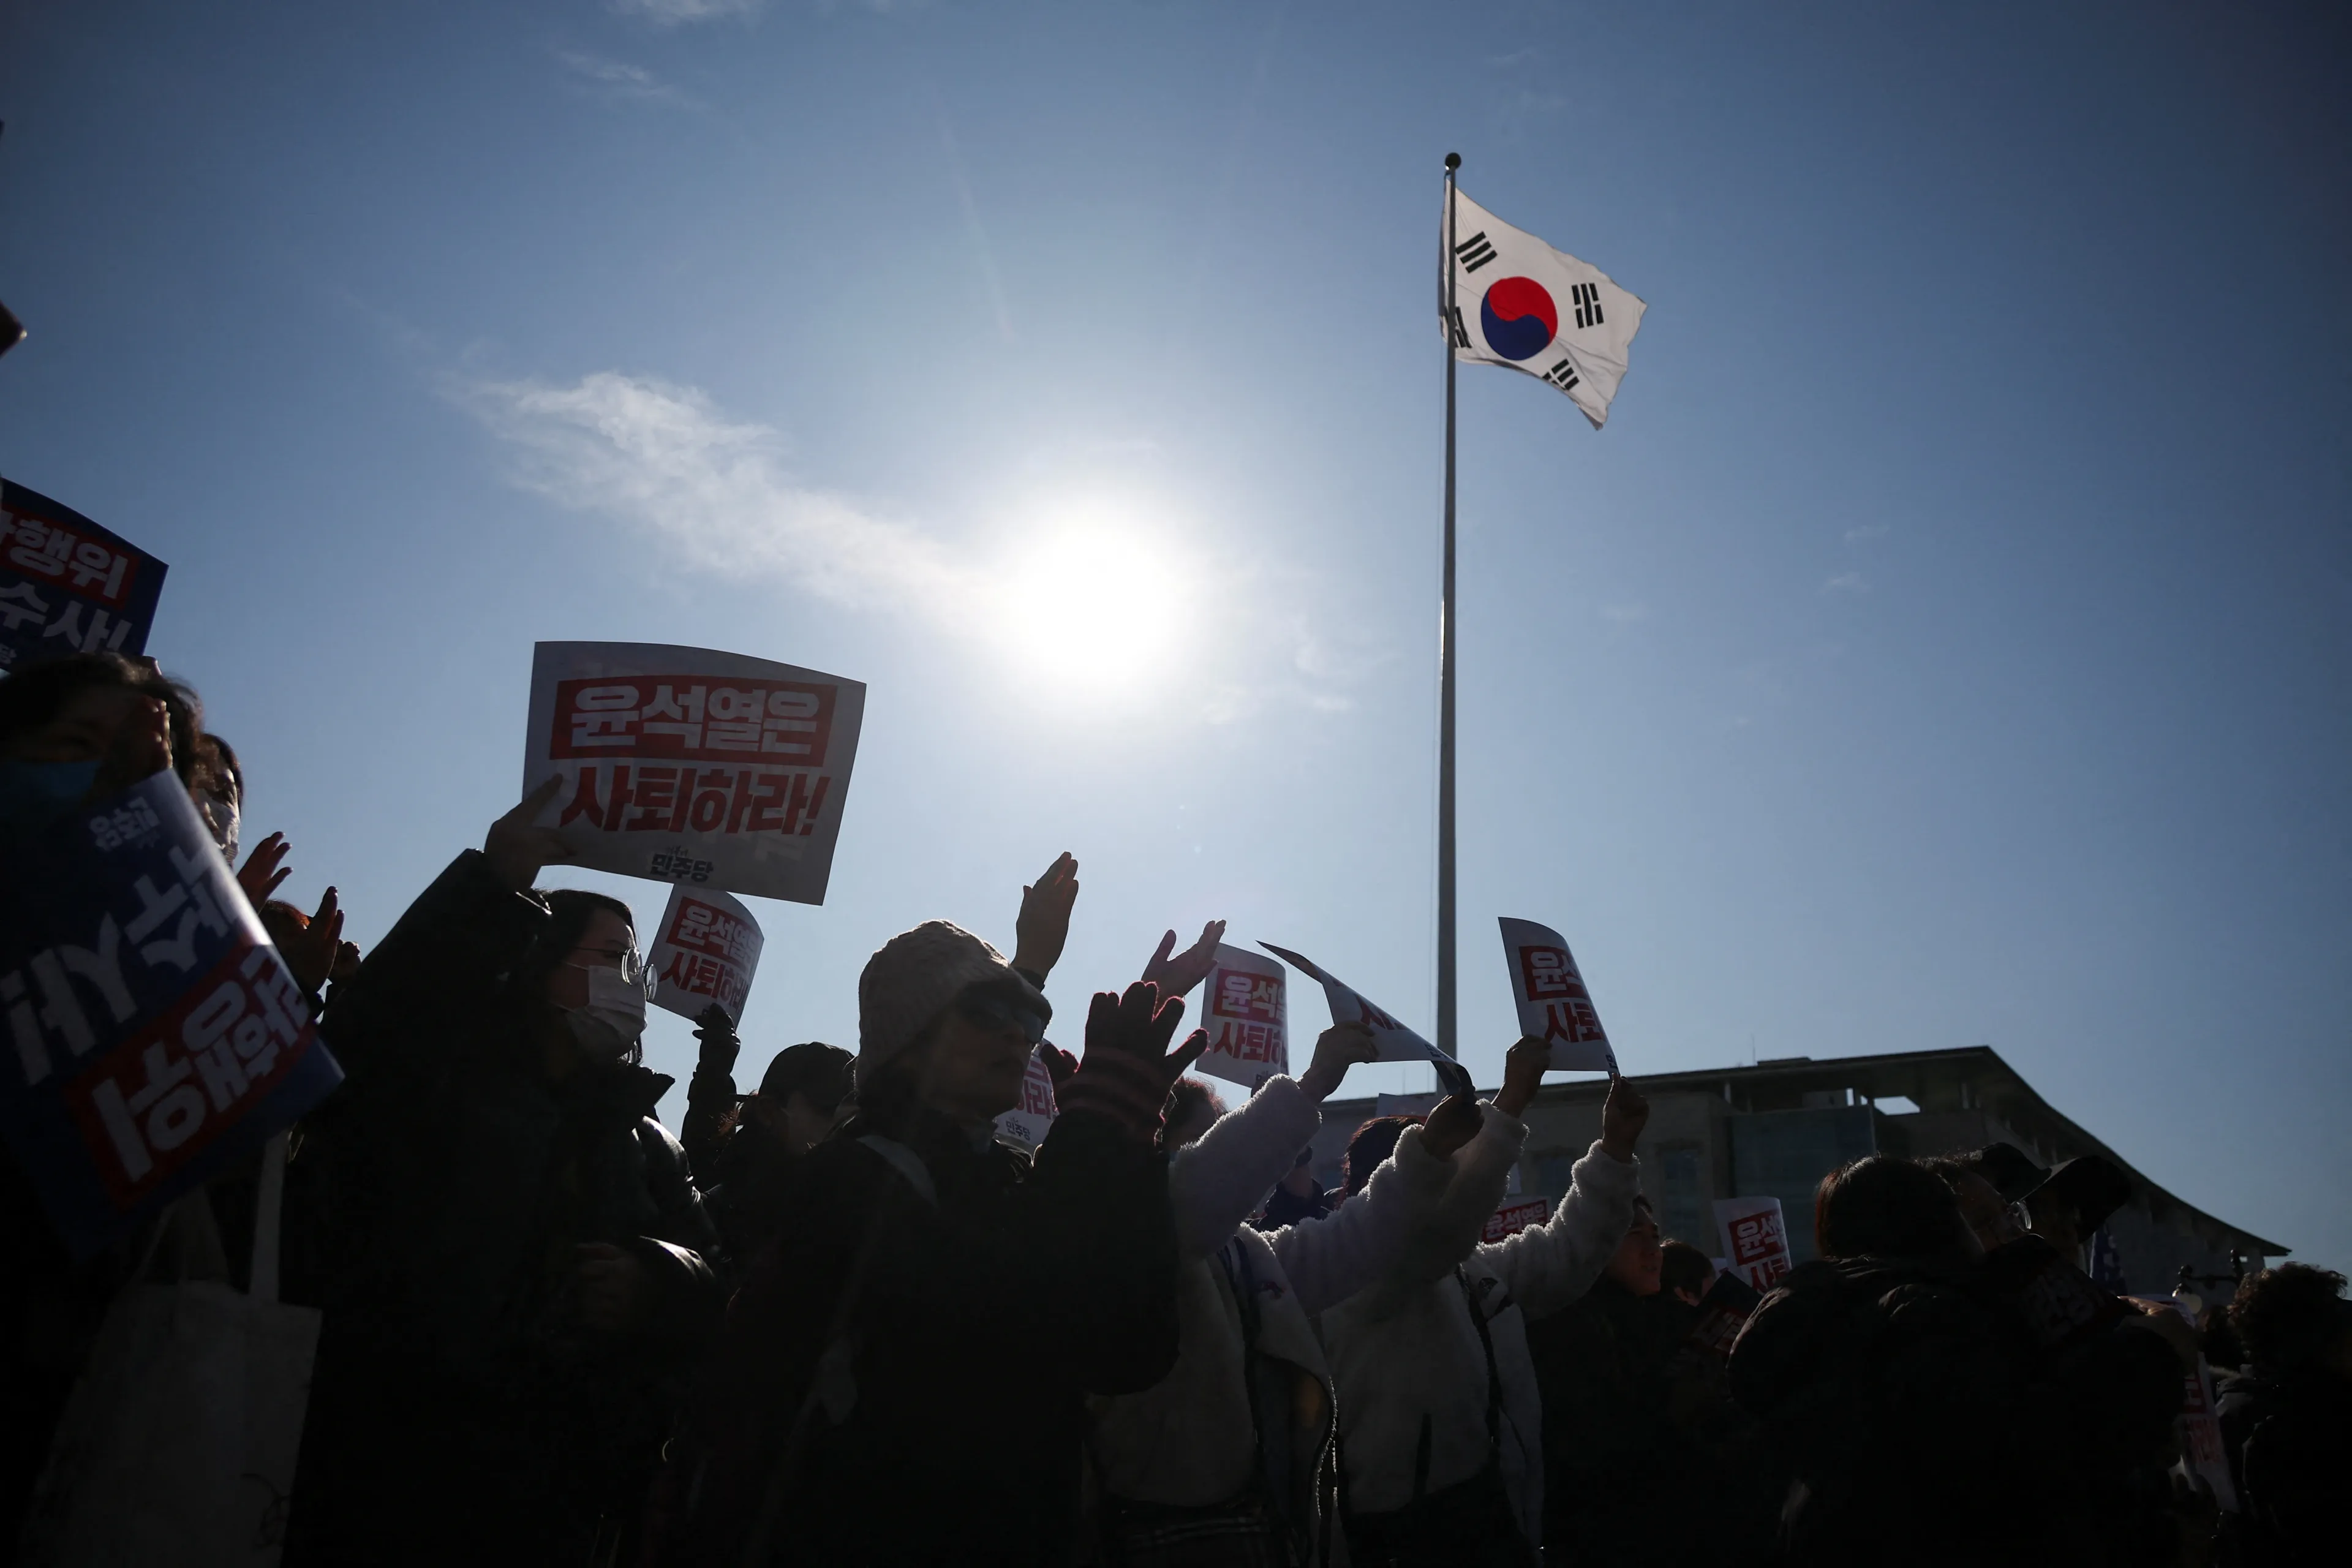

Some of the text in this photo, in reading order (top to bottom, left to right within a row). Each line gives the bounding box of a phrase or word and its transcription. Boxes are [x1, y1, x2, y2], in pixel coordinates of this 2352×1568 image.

[571, 685, 820, 755] 윤석열은
[560, 766, 831, 835] 사퇴하라!
[650, 854, 714, 883] 민주당
